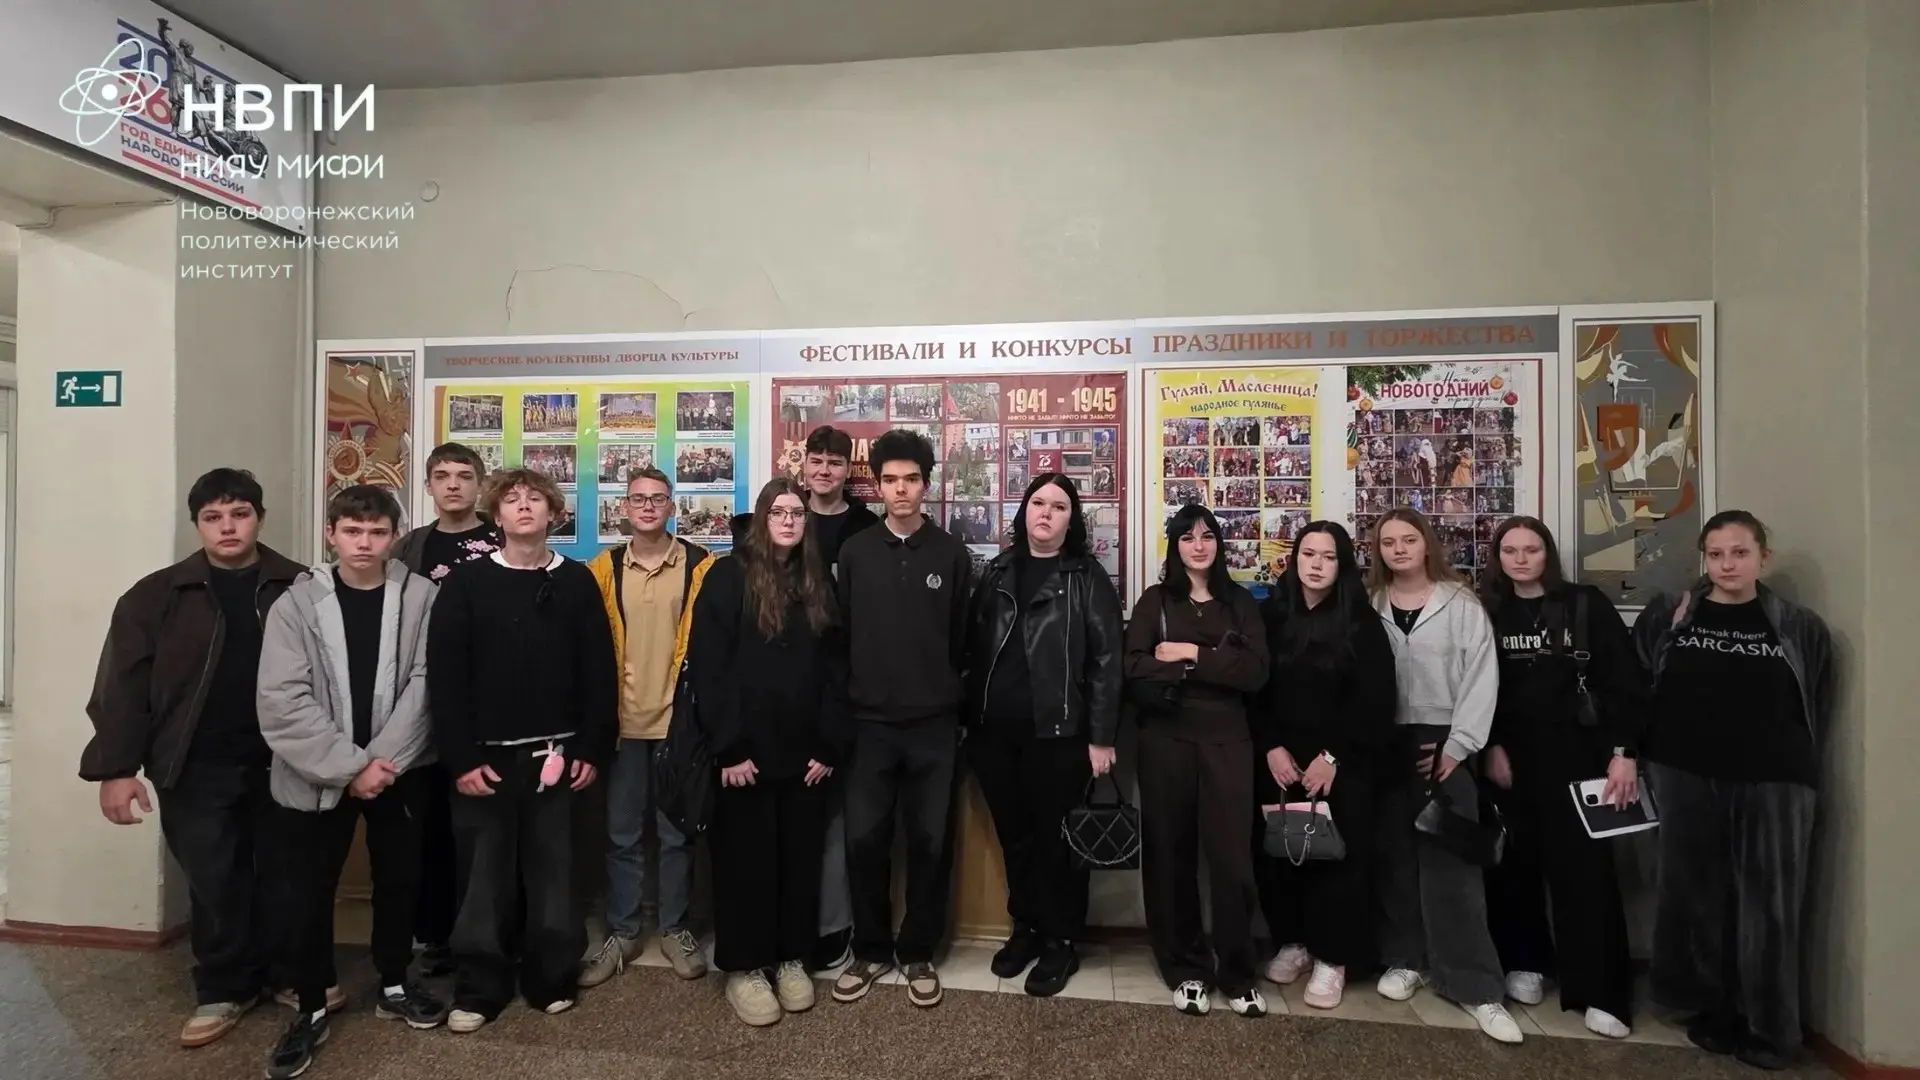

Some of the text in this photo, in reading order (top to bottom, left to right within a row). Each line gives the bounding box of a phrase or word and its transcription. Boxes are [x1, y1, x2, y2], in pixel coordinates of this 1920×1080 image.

[120, 122, 226, 174] ГОД ЕДИНС
[121, 135, 189, 171] НАРОДО
[799, 337, 1132, 362] ФЕСТИВАЛИ И КОНКУРСЫ
[1152, 324, 1535, 354] ПРАЗДНИКИ И ТОРЖЕСТВА
[445, 351, 739, 367] ТВОРЧЕСКИЕ КОЛЛЕКТИВЫ ДВОРЦА КУЛЬТУРЫ
[1006, 388, 1048, 413] 1941
[1071, 387, 1117, 412] 1945
[1160, 379, 1319, 401] Гуляй, Масленица!
[1380, 379, 1490, 399] НОВОГОДНИЙ
[1675, 635, 1783, 657] SARCASM
[1732, 630, 1768, 640] fluent
